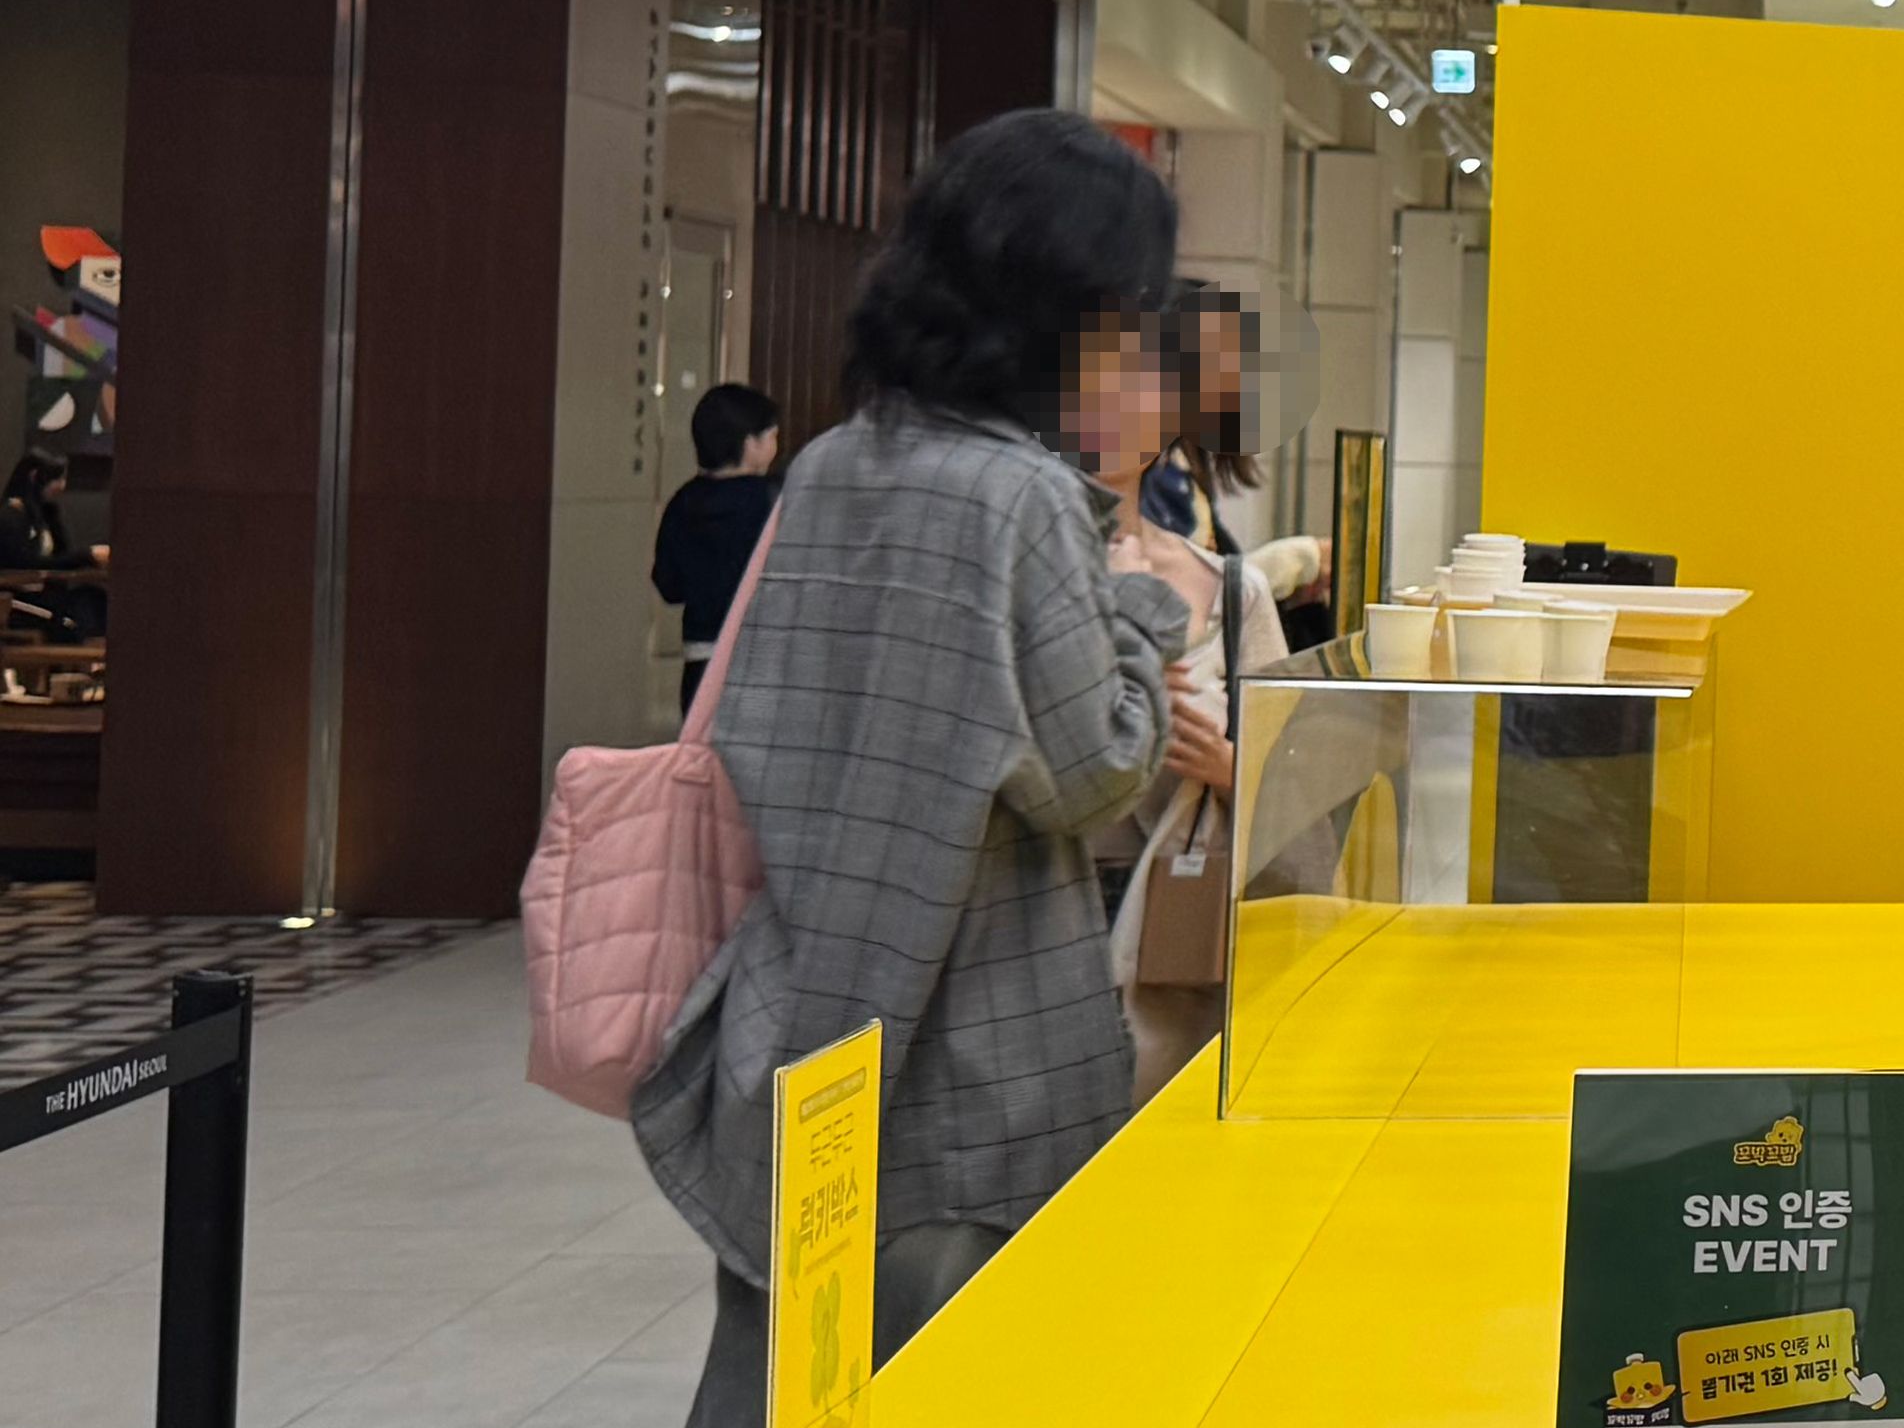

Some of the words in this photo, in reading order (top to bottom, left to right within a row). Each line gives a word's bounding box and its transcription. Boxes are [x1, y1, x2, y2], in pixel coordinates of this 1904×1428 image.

[46, 1091, 66, 1114] THE
[67, 1059, 138, 1111] HYUNDAI
[1683, 1194, 1768, 1227] SNS
[1779, 1190, 1852, 1229] 인증
[1694, 1239, 1837, 1273] EVENT
[1706, 1348, 1739, 1365] 아래
[1744, 1343, 1776, 1362] SNS
[1761, 1365, 1788, 1387] 1회
[1795, 1358, 1837, 1382] 제공!
